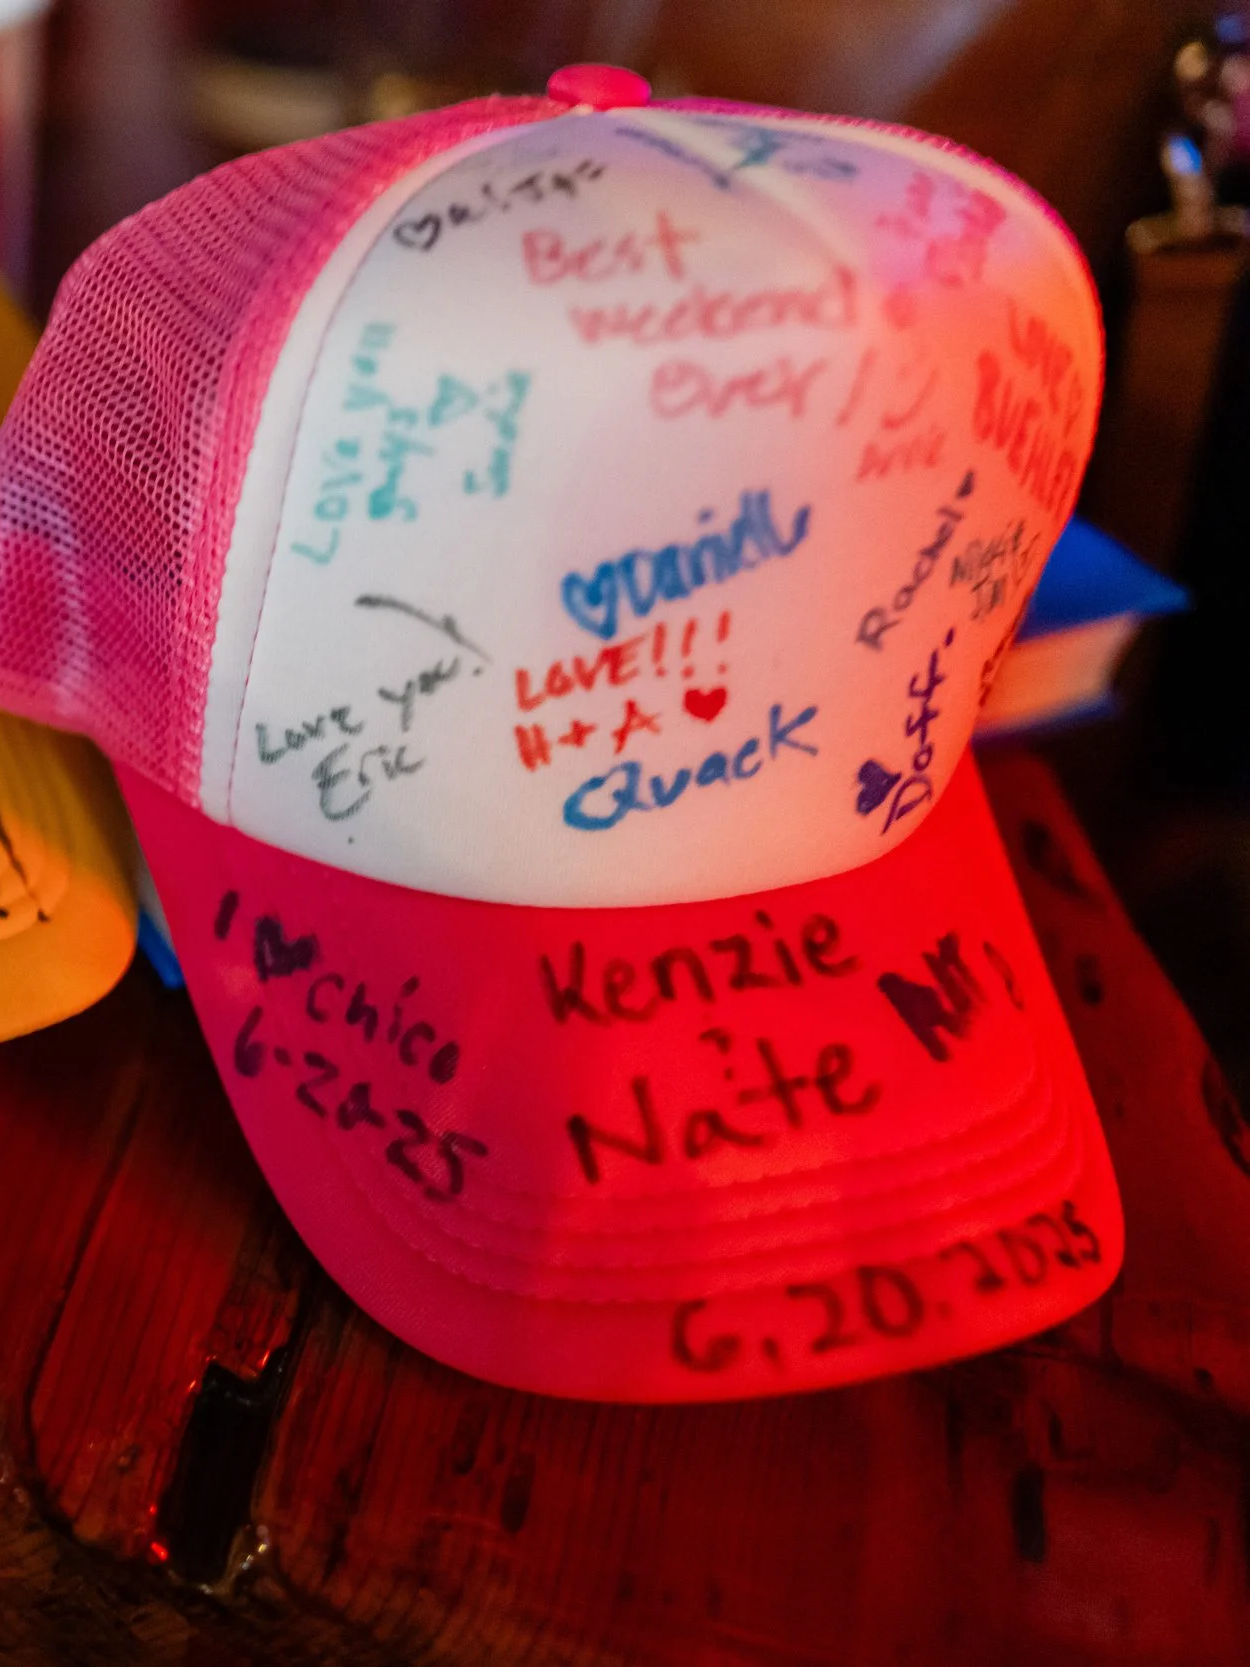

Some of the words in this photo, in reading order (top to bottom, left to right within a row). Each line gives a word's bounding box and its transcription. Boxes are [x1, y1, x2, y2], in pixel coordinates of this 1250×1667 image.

[521, 208, 699, 288] Best
[255, 705, 364, 764] Love
[311, 742, 425, 822] Eric
[562, 702, 820, 832] Quack
[540, 908, 862, 1026] Kenzie
[565, 1036, 882, 1186] Nate
